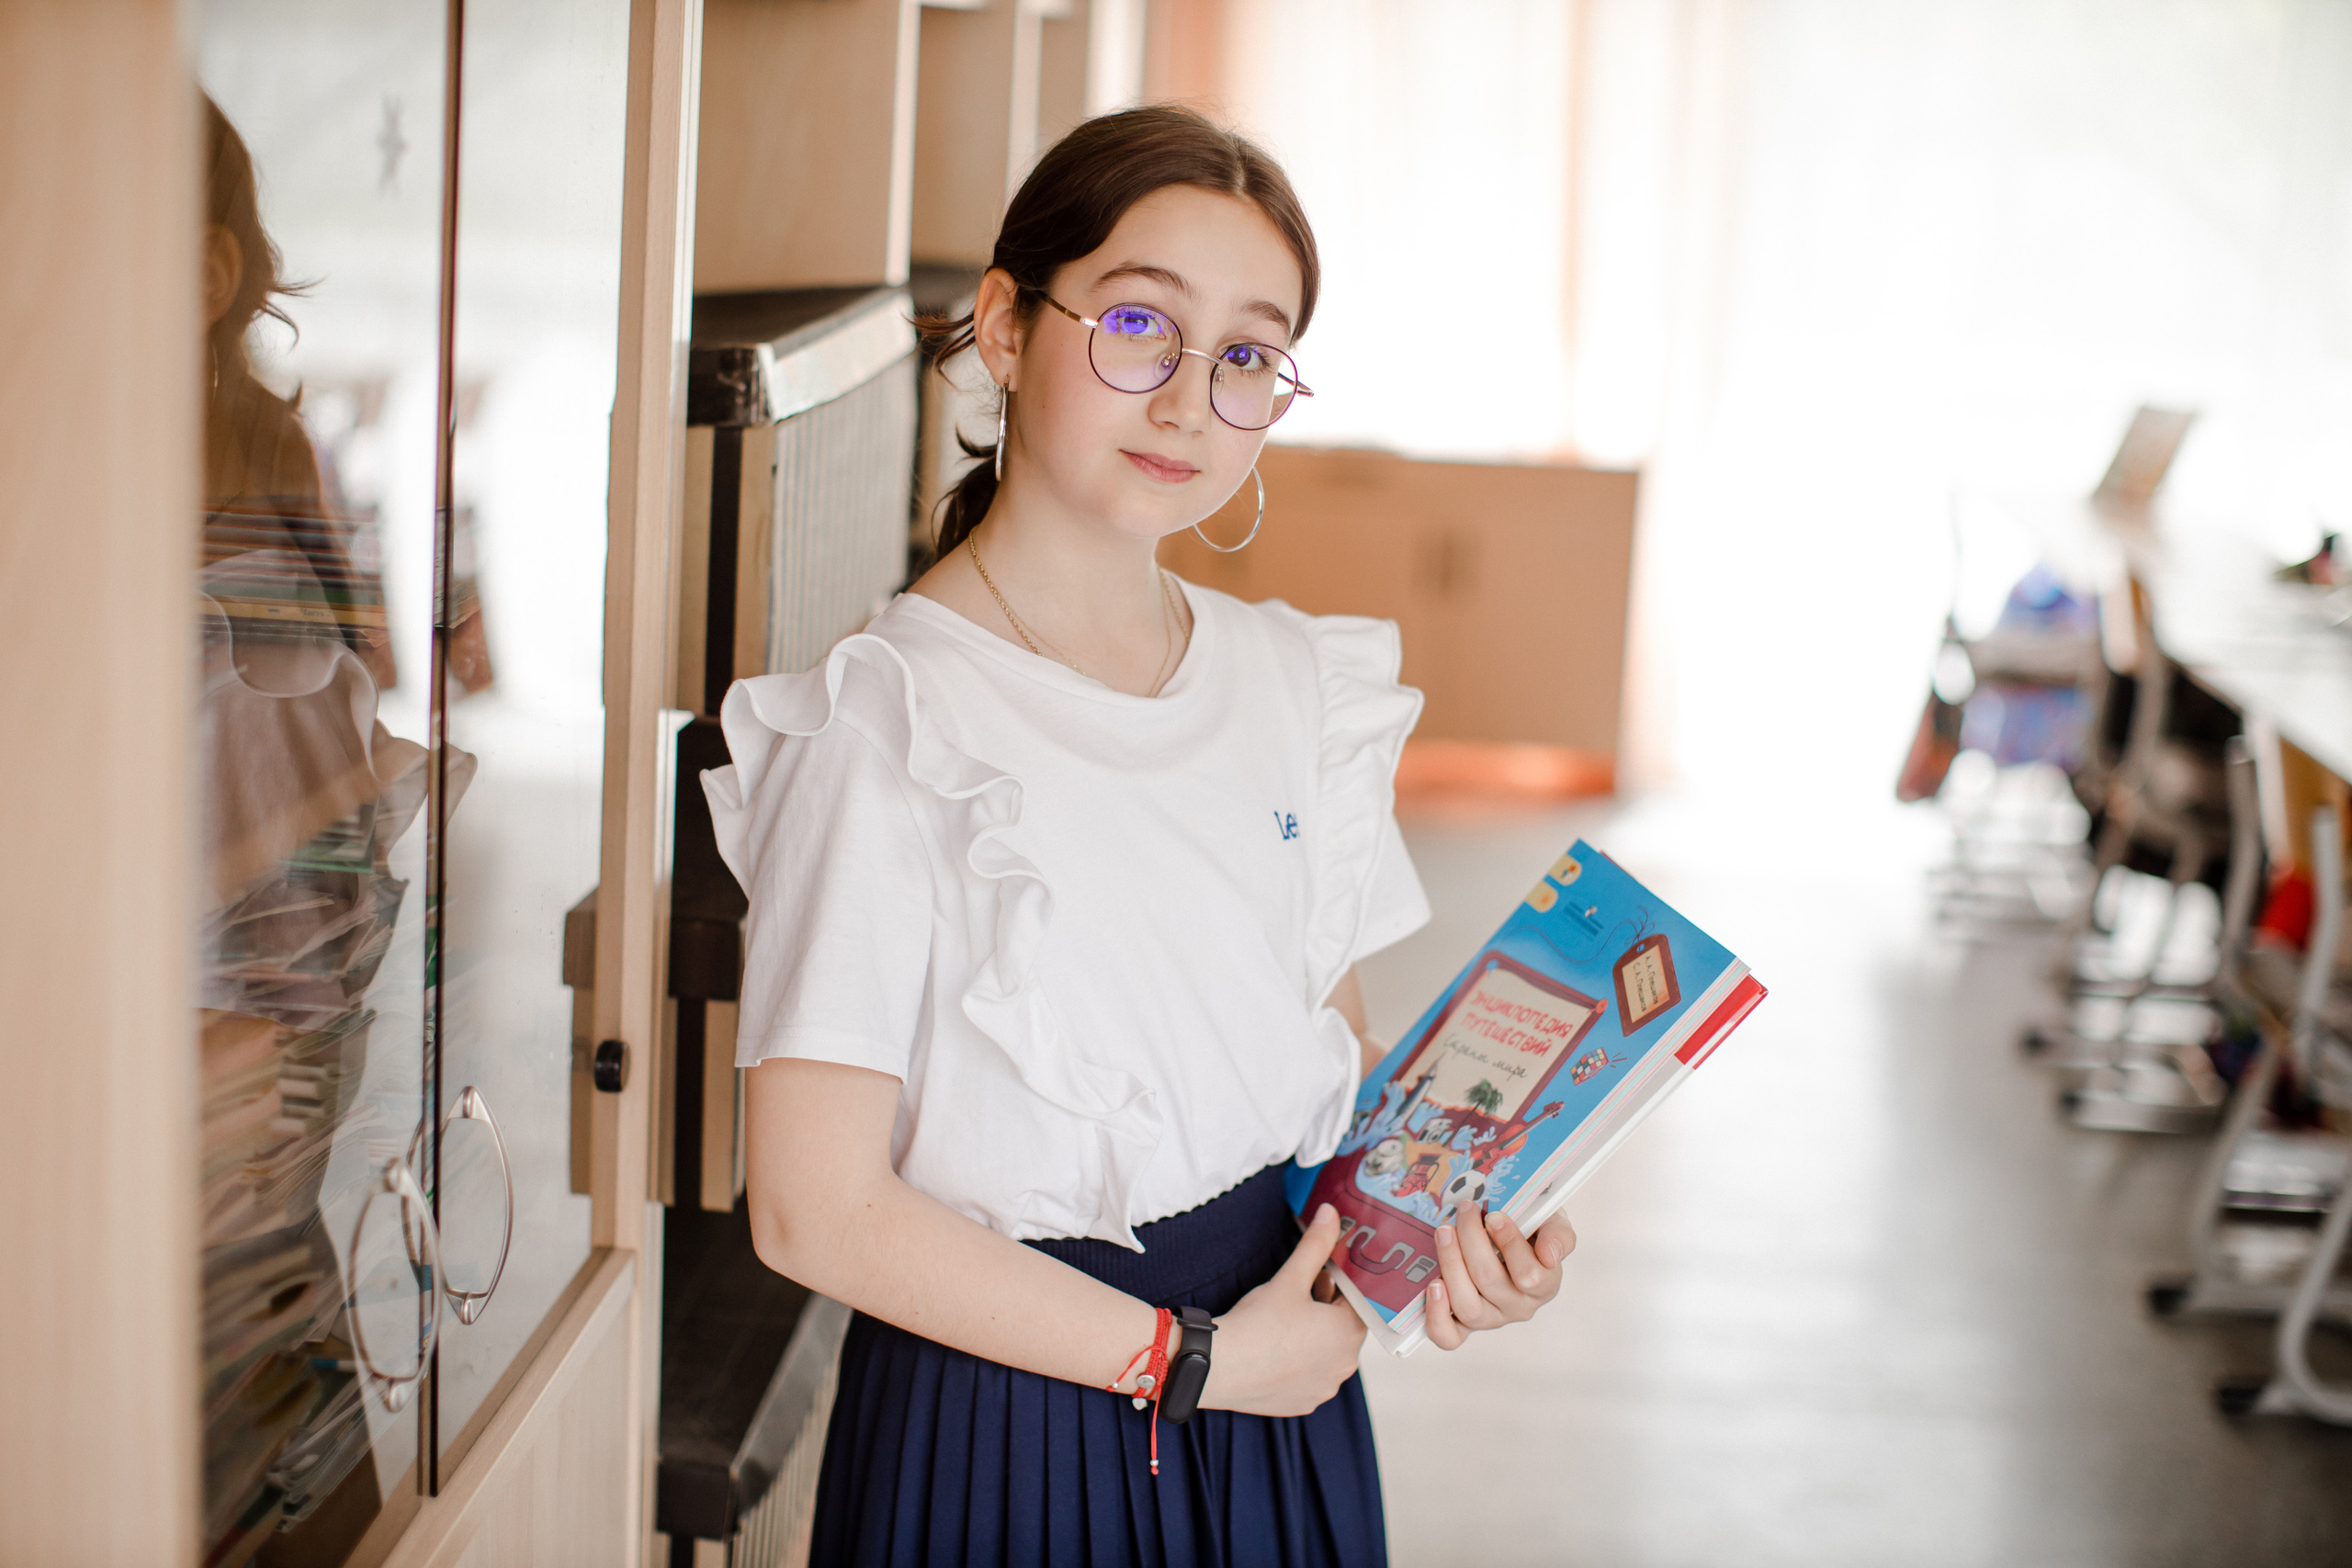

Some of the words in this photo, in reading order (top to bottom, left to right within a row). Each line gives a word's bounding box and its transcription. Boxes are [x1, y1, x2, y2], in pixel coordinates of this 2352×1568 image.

[1462, 1011, 1553, 1057] ПУТЕШЕСТВИЙ
[1470, 990, 1573, 1038] ЭНЦИКЛОПЕДИЯ
[1493, 1060, 1528, 1082] мира
